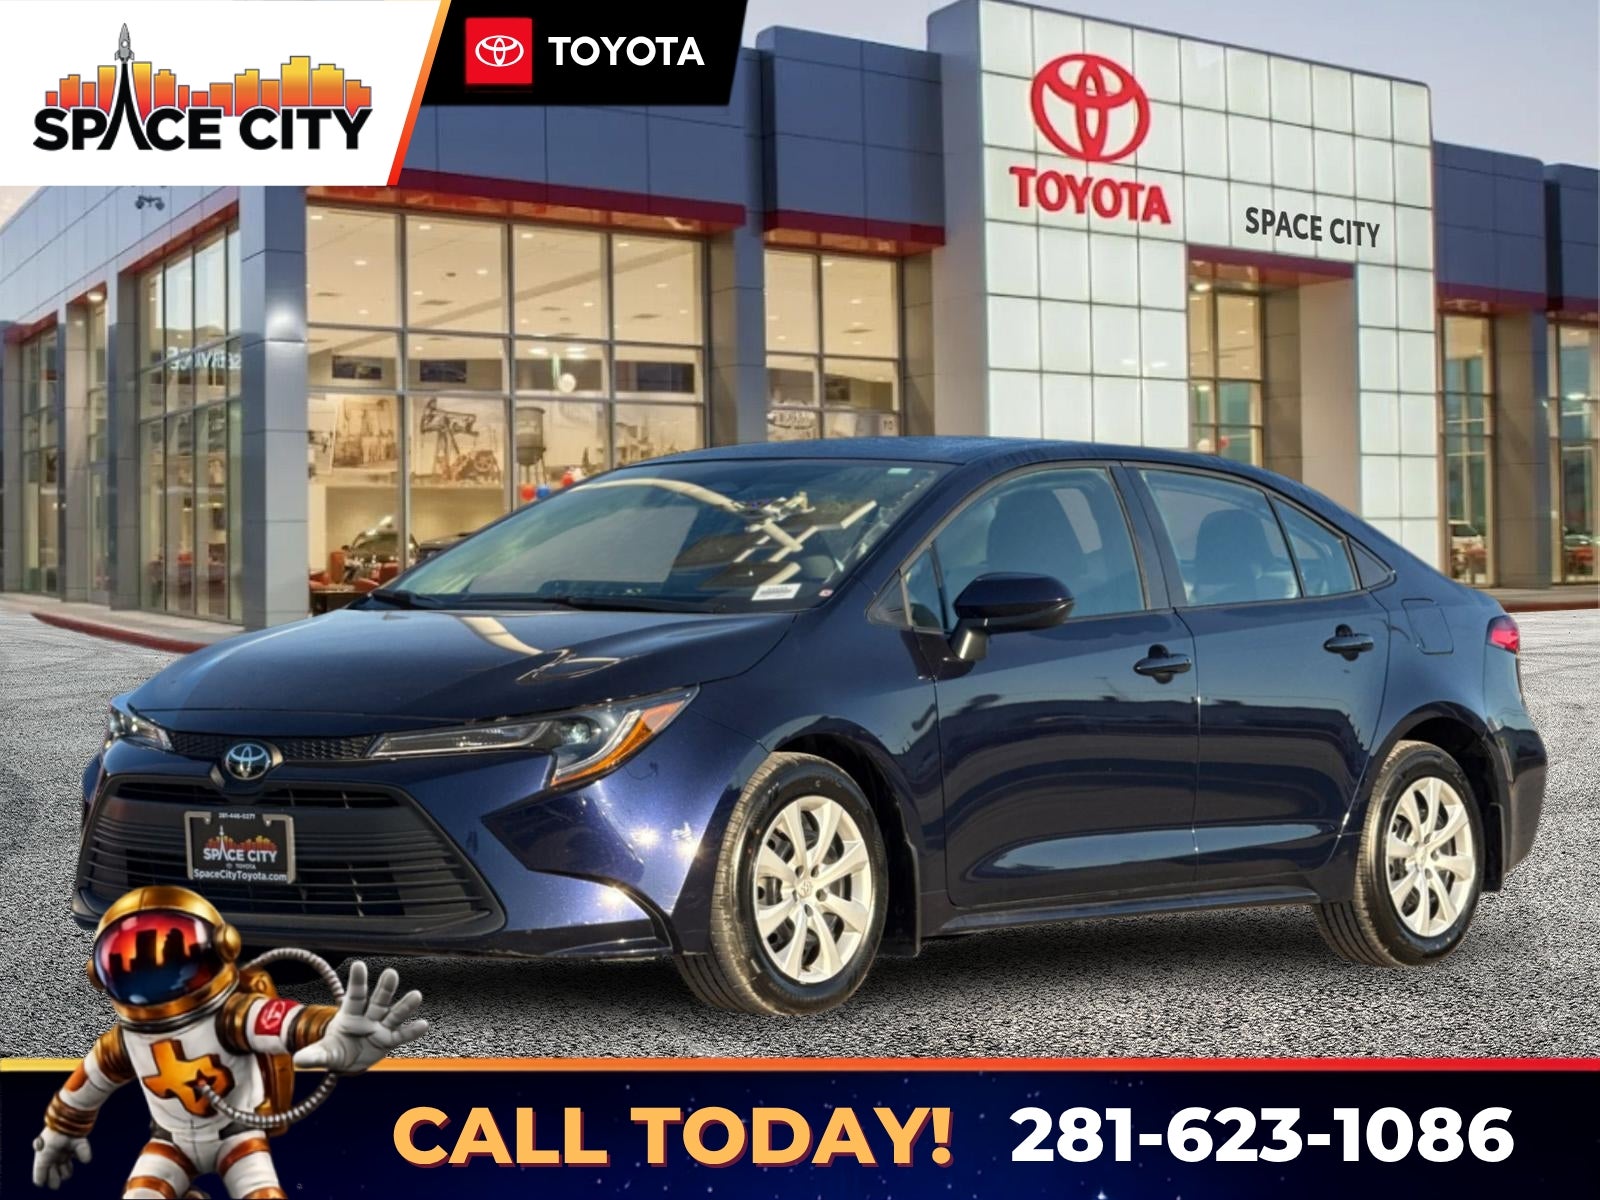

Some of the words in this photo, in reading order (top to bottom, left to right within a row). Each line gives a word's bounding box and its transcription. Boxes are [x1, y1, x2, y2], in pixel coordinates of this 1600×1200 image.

[1009, 166, 1171, 224] TOYOTA
[1244, 206, 1323, 242] SPACE
[1330, 217, 1381, 248] CITY
[203, 847, 244, 861] SPACE
[247, 850, 278, 862] CITY
[194, 869, 287, 881] SpaceCityToyota.com
